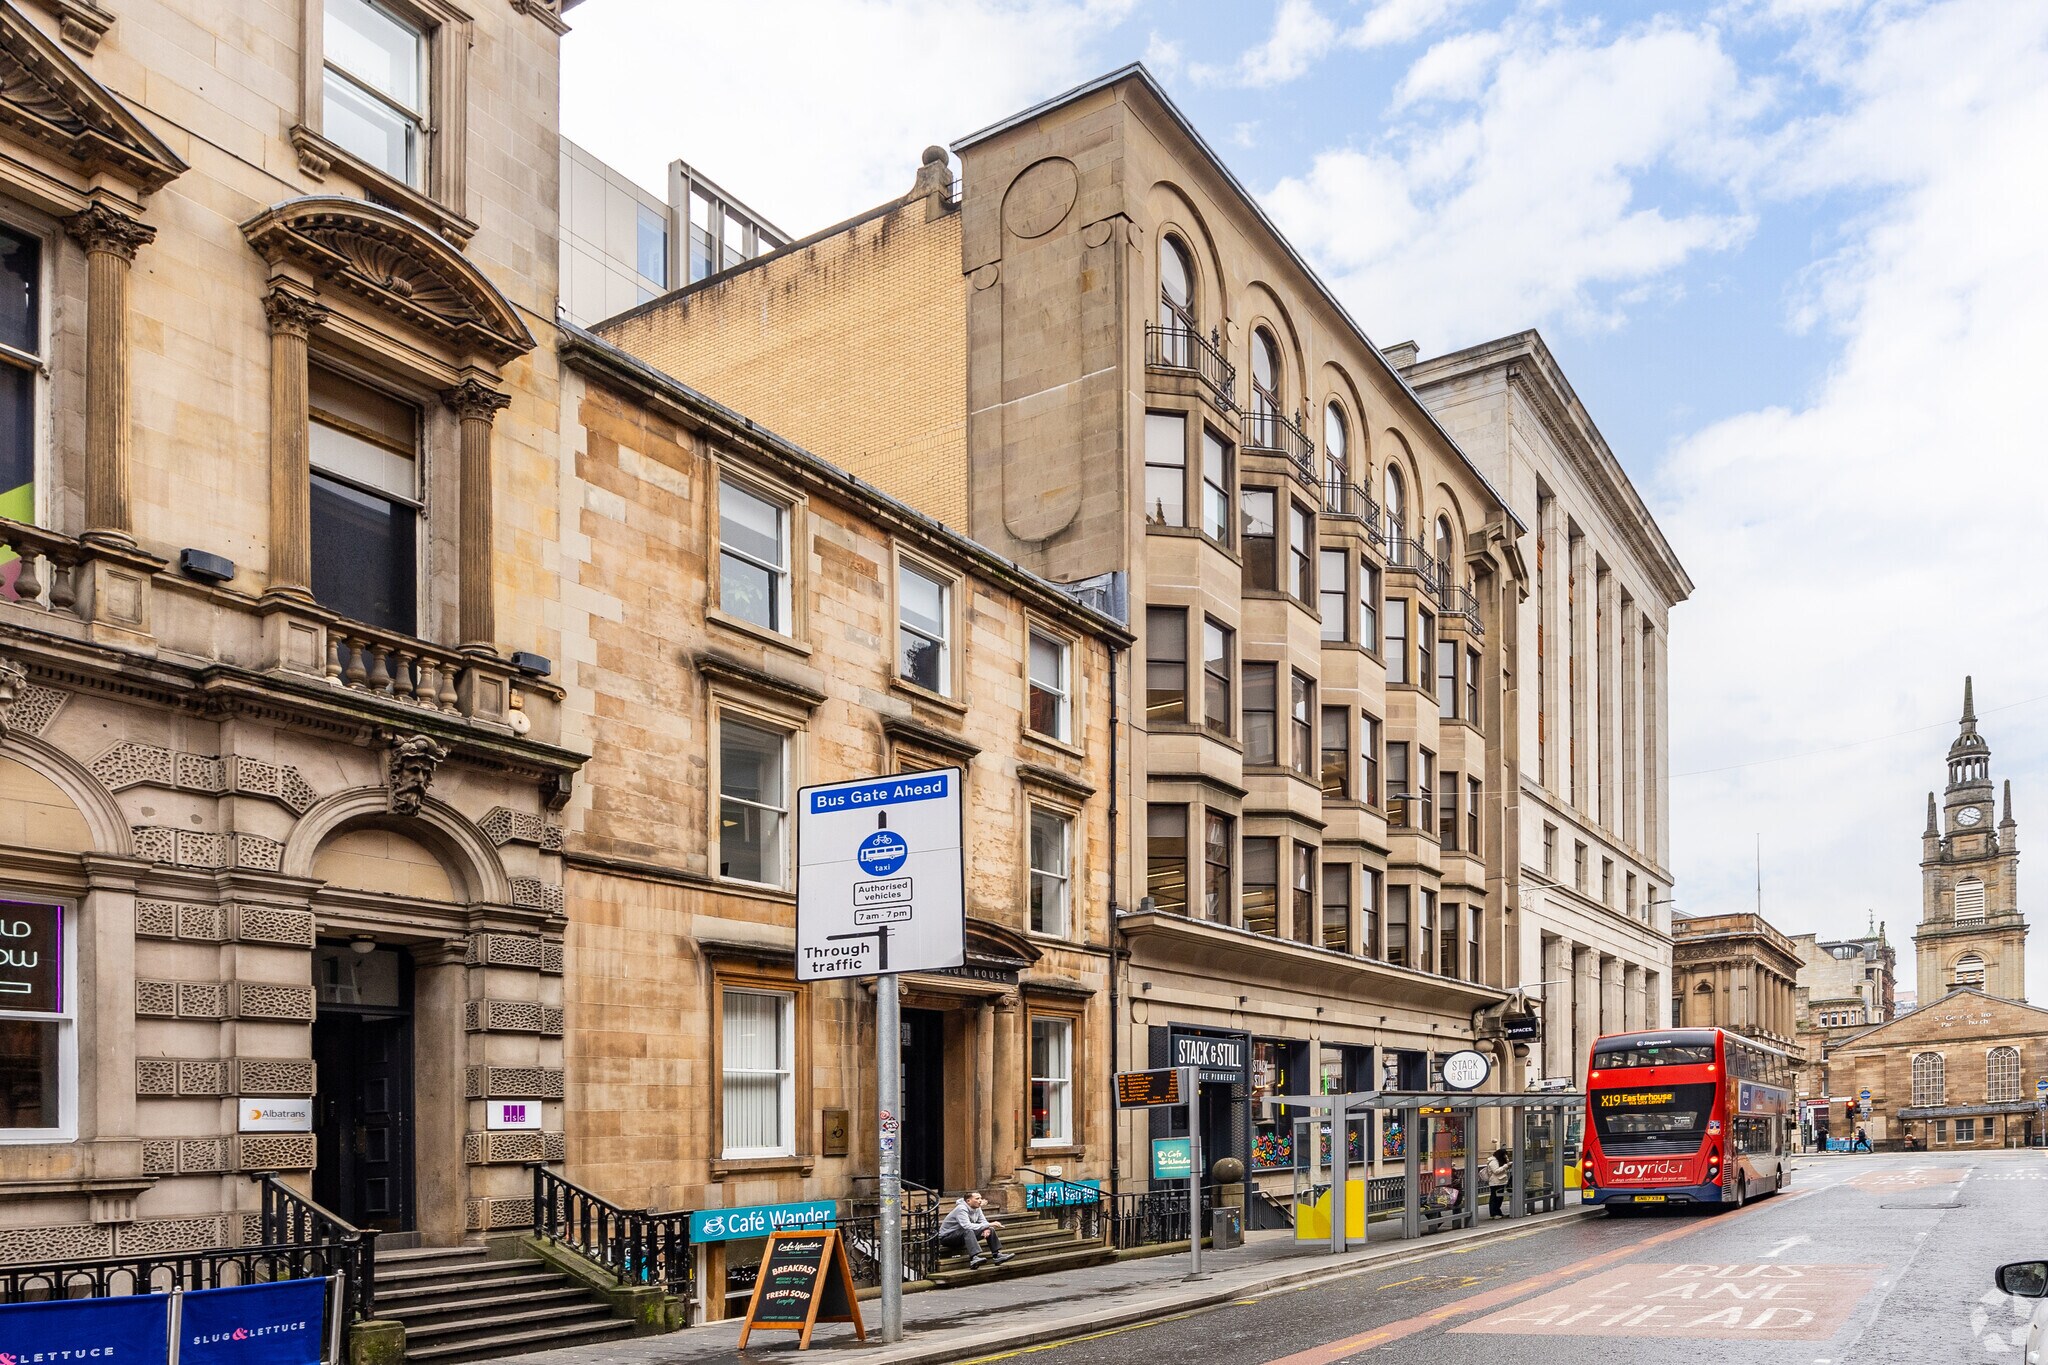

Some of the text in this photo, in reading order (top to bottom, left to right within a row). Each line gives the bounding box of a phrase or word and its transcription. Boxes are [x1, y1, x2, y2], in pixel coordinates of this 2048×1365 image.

[817, 780, 943, 808] Bus Gate Ahead
[874, 863, 891, 872] taxi
[858, 881, 908, 893] Authorised
[864, 890, 902, 901] vehicles
[803, 942, 870, 959] Through
[812, 958, 863, 973] traffic
[974, 969, 1007, 980] HOUSE
[1178, 1040, 1242, 1067] STACK & STILL
[1253, 1060, 1269, 1072] STACK
[1451, 1060, 1478, 1071] STACK
[1211, 1073, 1236, 1082] PIONEERS
[1457, 1070, 1480, 1081] STILL
[1601, 1093, 1673, 1107] X19 Easterhouse
[262, 1109, 306, 1117] Albatrans
[728, 1206, 831, 1233] Café Wander
[771, 1264, 817, 1276] BREAKFAST
[1656, 1264, 1820, 1279] BUS
[766, 1290, 811, 1300] FRESH SOUP
[1588, 1281, 1828, 1300] LANE
[1486, 1304, 1817, 1330] AHEAD
